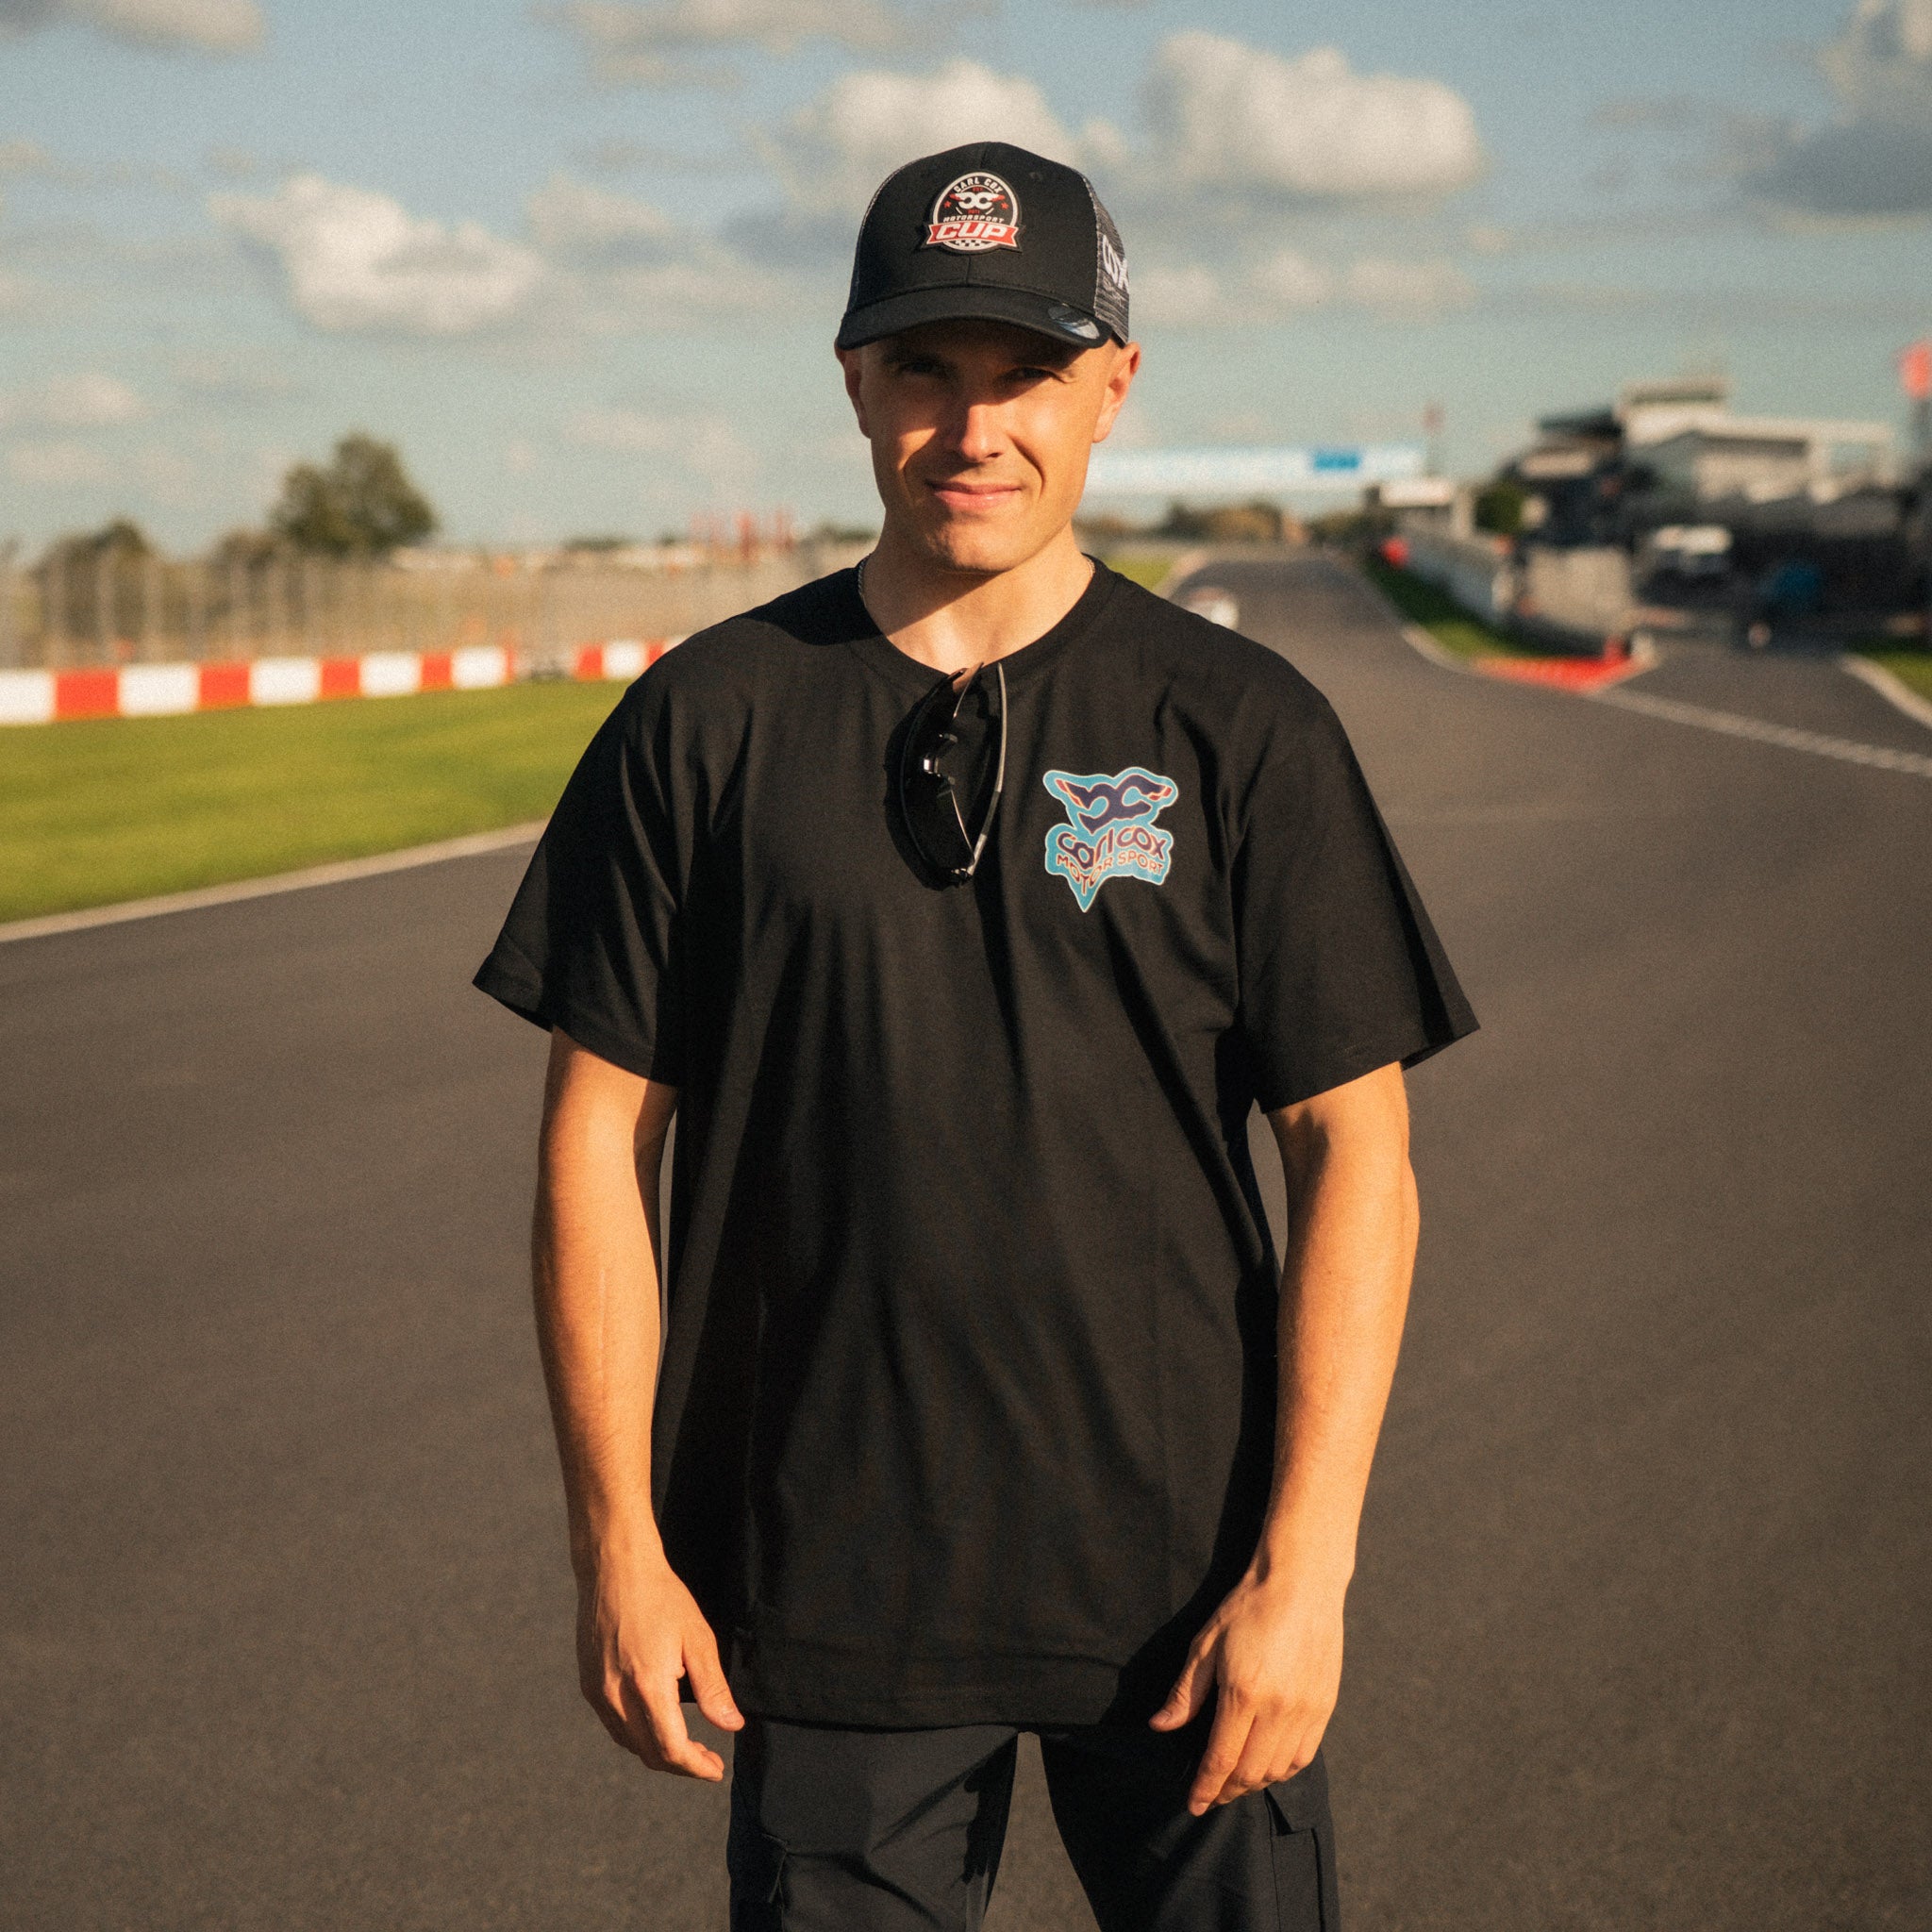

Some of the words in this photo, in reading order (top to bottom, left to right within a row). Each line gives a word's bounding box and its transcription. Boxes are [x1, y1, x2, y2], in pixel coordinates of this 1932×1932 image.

[953, 176, 980, 193] CARL
[984, 177, 1003, 193] COX
[943, 214, 1005, 224] MOTORSPORT
[936, 222, 1008, 241] CUP
